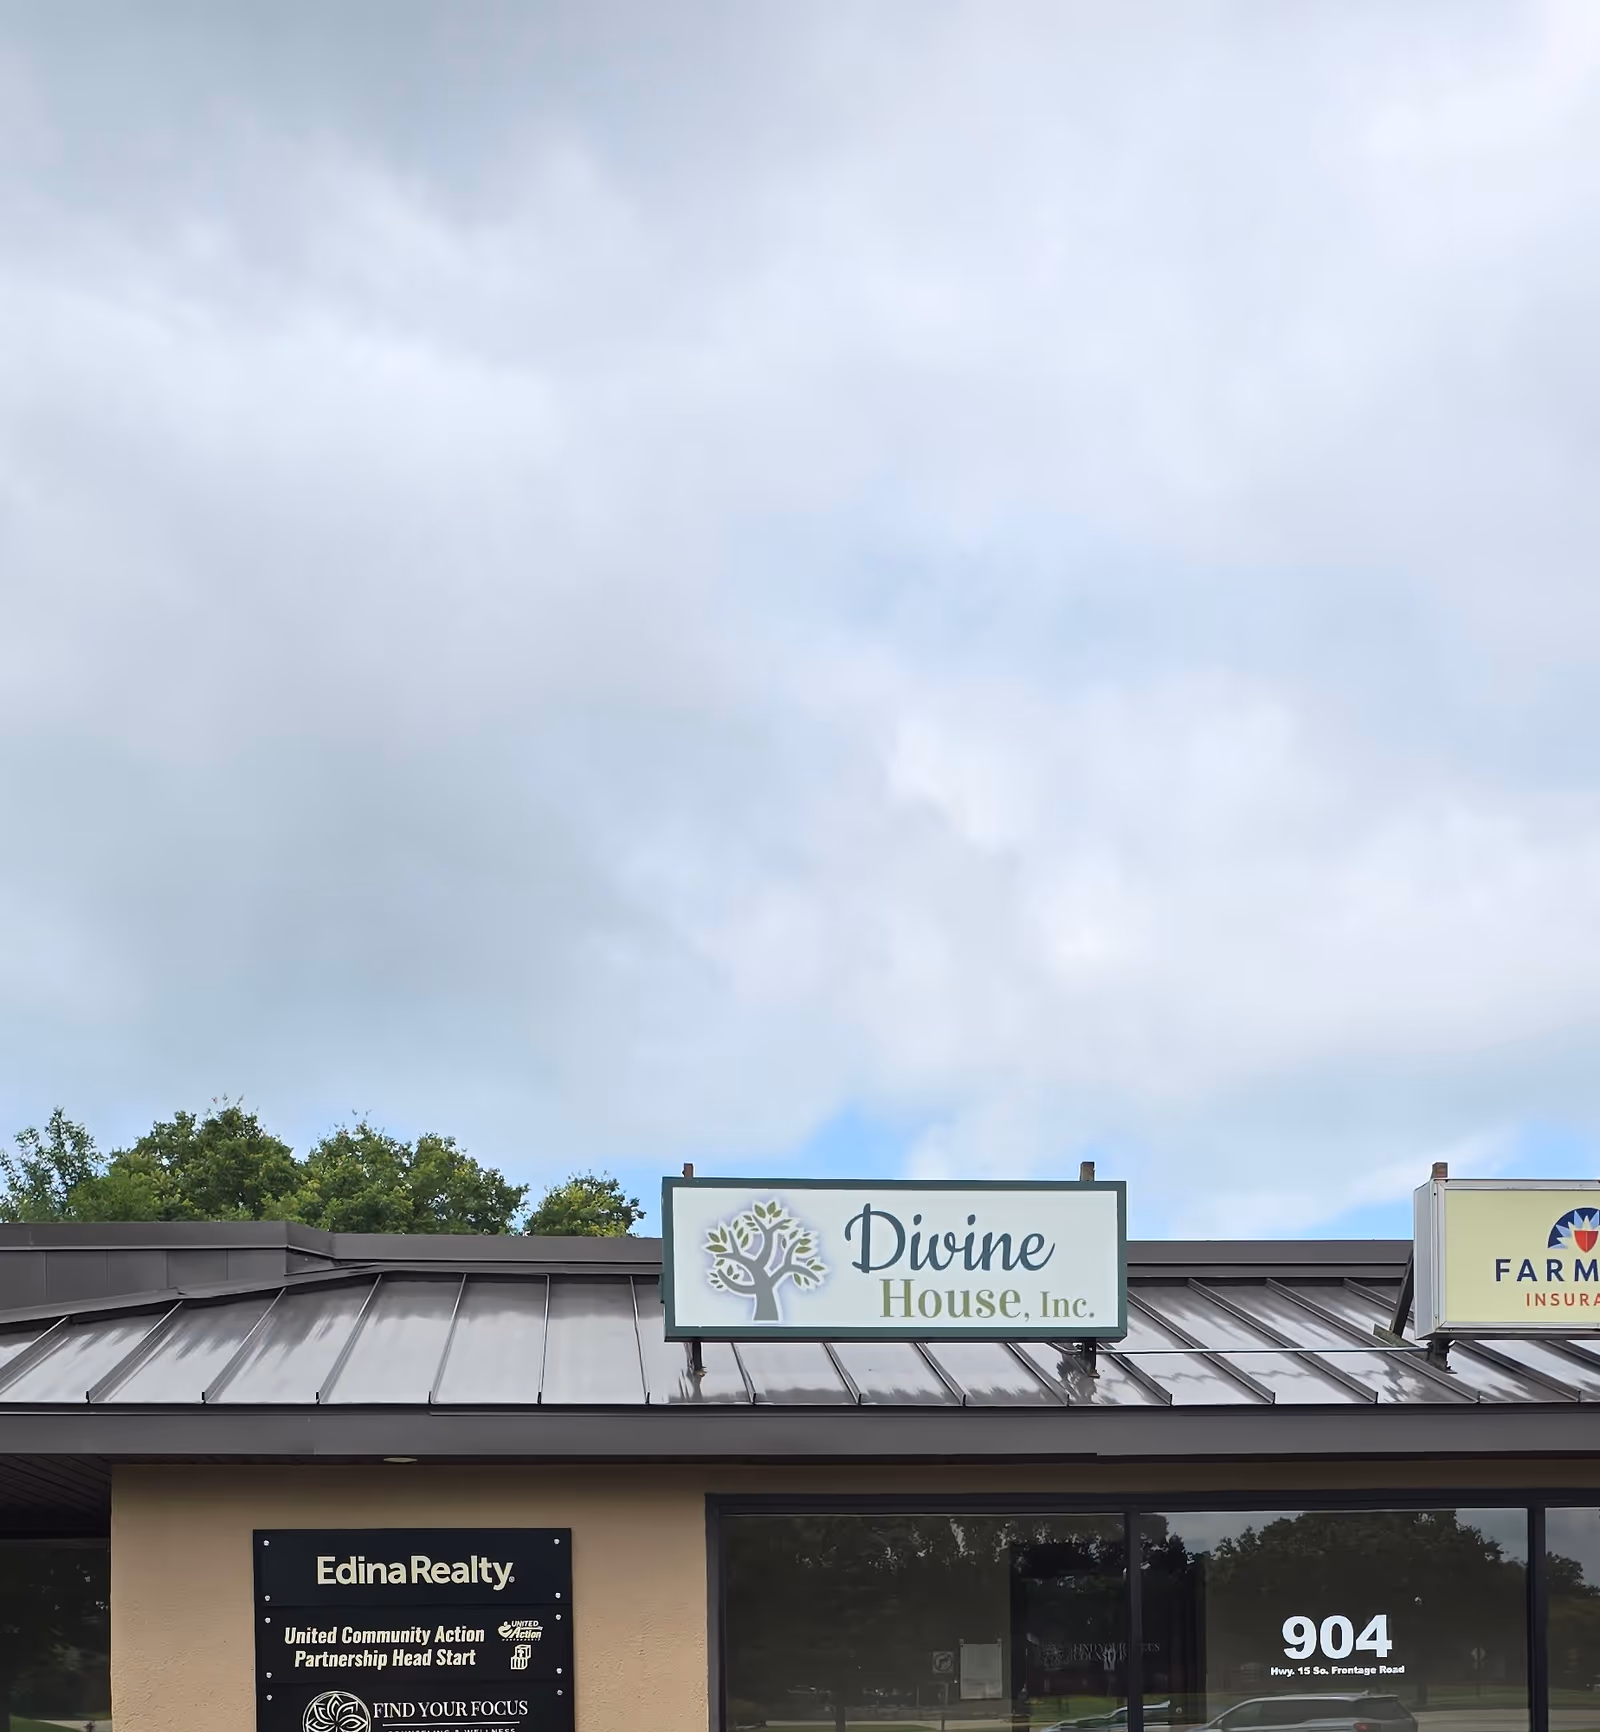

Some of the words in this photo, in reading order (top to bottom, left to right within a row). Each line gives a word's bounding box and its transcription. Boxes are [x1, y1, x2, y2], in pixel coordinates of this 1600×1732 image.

[845, 1203, 1056, 1274] Divine
[879, 1278, 1030, 1321] House,
[1039, 1291, 1095, 1318] Inc.
[508, 1626, 542, 1639] Action
[511, 1620, 540, 1628] UNITED
[284, 1626, 337, 1645] United
[341, 1626, 431, 1646] Community
[434, 1625, 485, 1643] Action
[1282, 1614, 1393, 1660] 904
[294, 1649, 388, 1671] Partnership
[392, 1648, 433, 1667] Head
[435, 1648, 476, 1666] Start
[1270, 1666, 1295, 1678] Hwy.
[1297, 1666, 1311, 1675] 15
[1312, 1666, 1329, 1675] So.
[1331, 1665, 1377, 1676] Frontage
[1379, 1664, 1405, 1674] Road
[373, 1702, 415, 1719] FIND
[418, 1701, 468, 1718] YOUR
[471, 1700, 528, 1717] FOCUS
